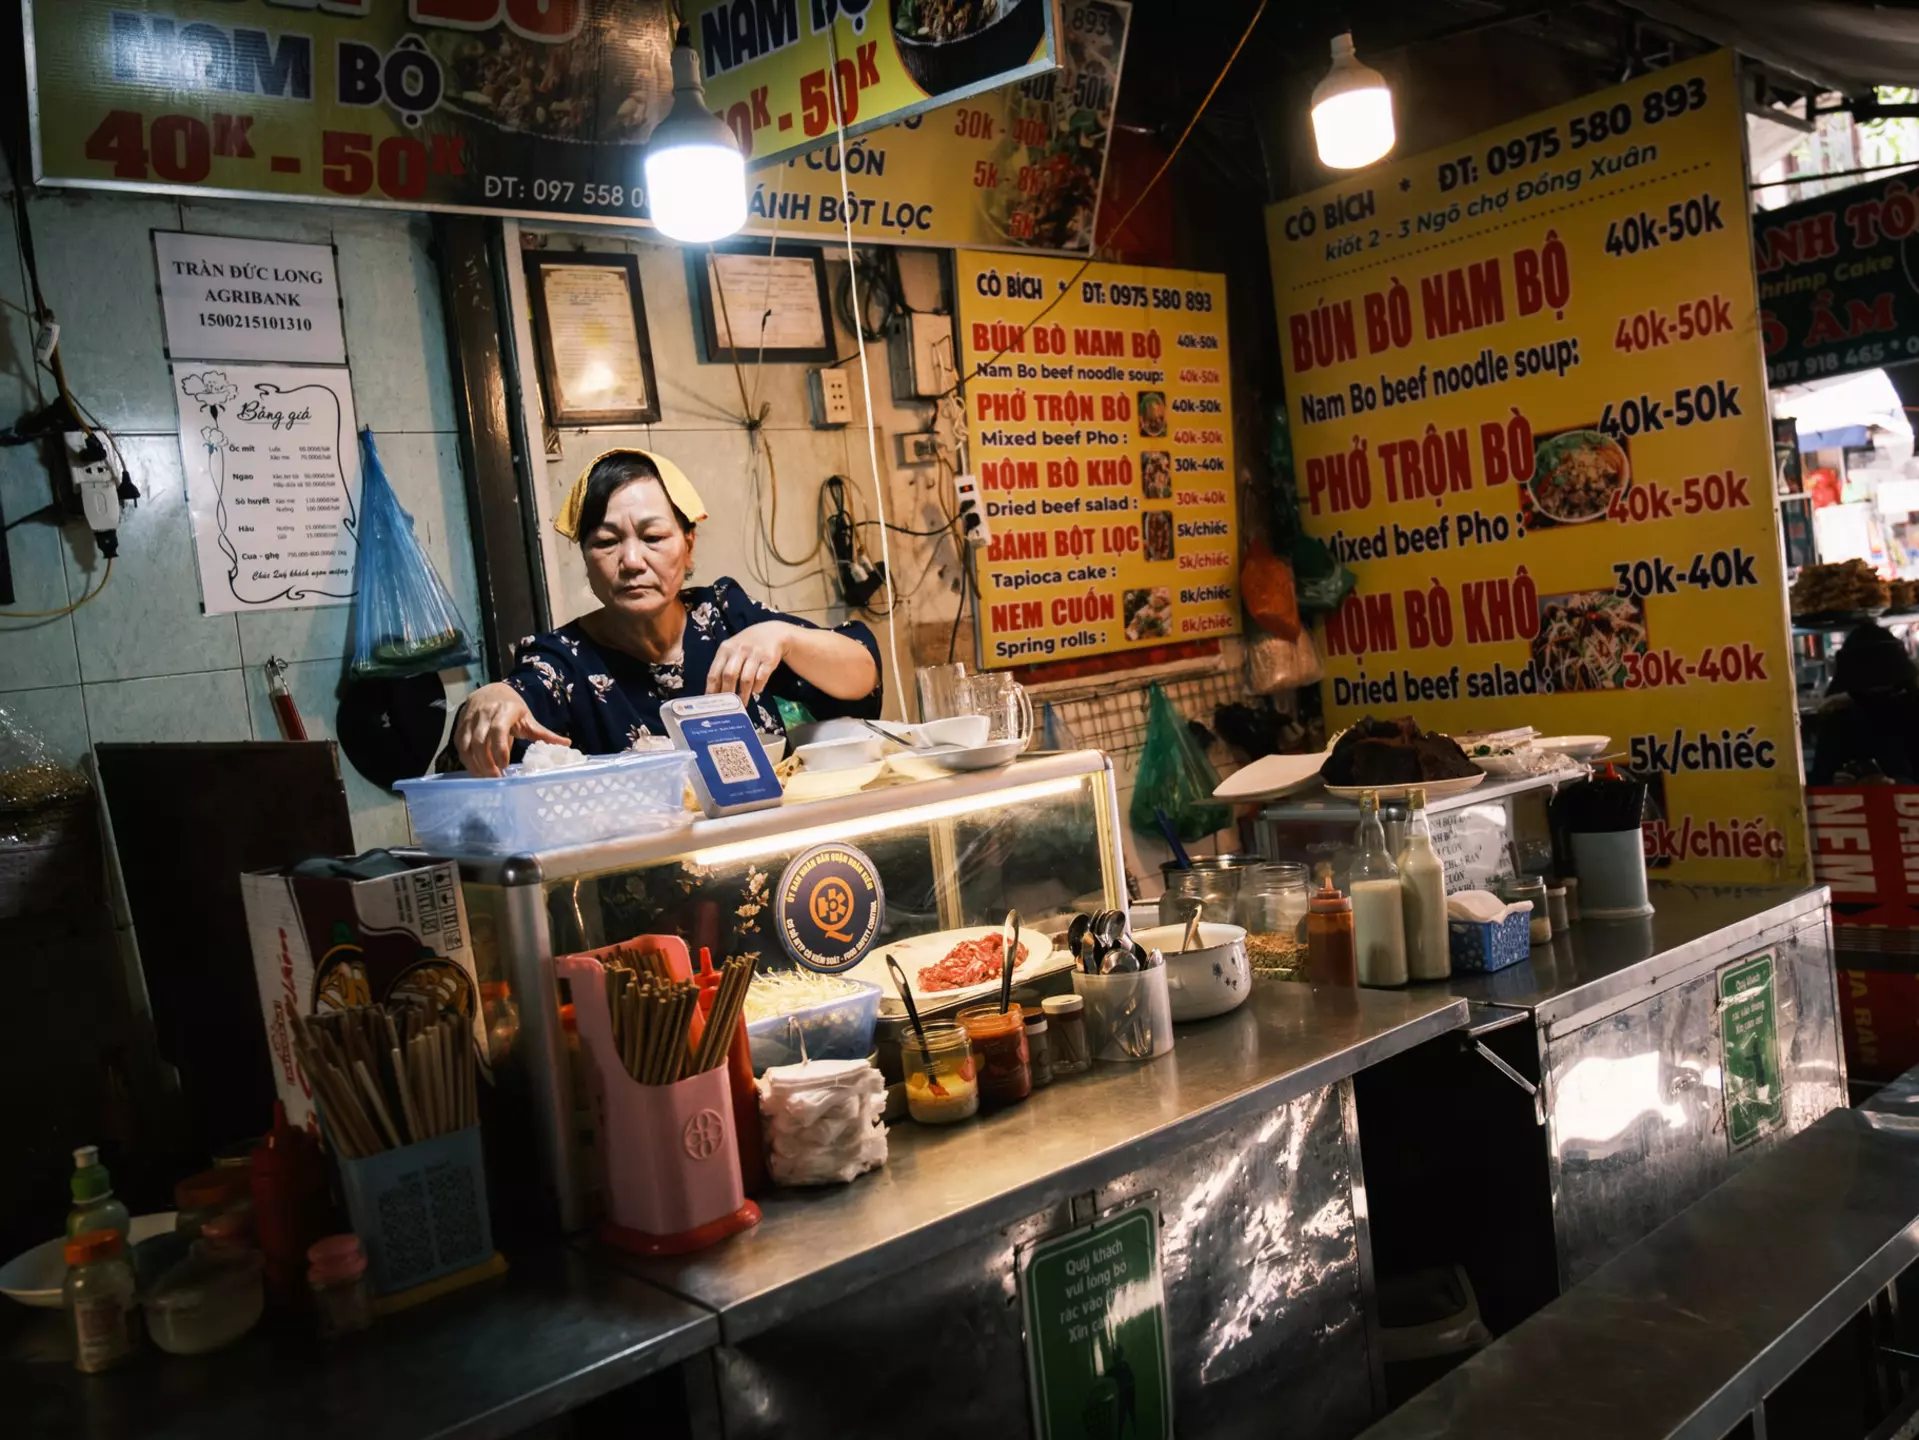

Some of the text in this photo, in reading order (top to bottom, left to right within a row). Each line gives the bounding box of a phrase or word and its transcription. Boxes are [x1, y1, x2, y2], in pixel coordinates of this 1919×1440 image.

[701, 0, 799, 78] NAM
[1073, 9, 1113, 36] 893
[338, 36, 442, 125] BỘ
[713, 40, 880, 158] 0K 50K
[955, 108, 995, 140] 30k
[1012, 117, 1048, 148] 40k
[85, 110, 465, 199] 40K 50K
[806, 138, 885, 176] CUỐN
[1284, 76, 1707, 242] CÔ BÍCH ĐT: 0975 580 893
[484, 176, 624, 206] ĐT: 097 558
[973, 160, 999, 189] 5k
[749, 183, 933, 235] ÁNH BỘT LỌC
[1325, 144, 1658, 262] kiốt 2 3 Ngõ chợ Đồng Xuân
[1846, 182, 1919, 248] TÔ
[1604, 194, 1724, 257] 40k-50k
[172, 258, 323, 285] TRẦN ĐỨC LONG
[976, 270, 1212, 312] CÔ BÍCH ĐT: 0975 580 893
[1761, 255, 1895, 299] hrimp Cake
[205, 288, 301, 307] AGRIBANK
[1289, 229, 1572, 374] BÚN BÒ NAM BỘ
[199, 313, 312, 331] 1500215101310
[972, 319, 1162, 364] BÚN BÒ NAM BỘ
[1614, 294, 1734, 354] 40k-50k
[1177, 334, 1219, 350] 40k-50k
[1805, 352, 1839, 375] 918
[1845, 342, 1884, 365] 465
[977, 363, 1164, 385] Nam Bo beef noodle soup:
[1179, 370, 1220, 384] 40k-50k
[1301, 337, 1581, 425] Nam Bo beef noodle soup:
[237, 400, 311, 430] Bảng giá
[977, 388, 1131, 427] PHỞ TRỘN BÒ
[1172, 400, 1222, 414] 40k-50k
[1599, 380, 1743, 440] 40k-50k
[981, 431, 1119, 446] Mixed beef Pho
[1173, 431, 1223, 444] 40k-50k
[232, 473, 254, 481] Ngao
[982, 456, 1133, 495] NỘM BÒ KHÔ
[1174, 458, 1225, 473] 30k-40k
[1306, 406, 1536, 517] PHỞ TRỘN BÒ
[986, 496, 1129, 517] Dried beef salad
[1175, 491, 1226, 506] 30k-40k
[1607, 470, 1751, 525] 40k-50k
[987, 524, 1140, 562] BÁNH BỘT LỌC
[1177, 521, 1228, 537] 5k/chiếc
[1394, 515, 1449, 556] beef
[1457, 510, 1510, 548] Pho
[992, 566, 1107, 590] Tapioca cake
[1178, 551, 1230, 569] 5k/chiếc
[1612, 548, 1758, 598] 30k-40k
[991, 587, 1114, 633] NEM CUỐN
[1180, 583, 1231, 603] 8k/chiếc
[1407, 577, 1454, 649] BÒ
[1461, 564, 1540, 645] KHÔ
[1181, 614, 1232, 633] 8k/chiếc
[996, 631, 1098, 658] Spring rolls
[1334, 659, 1540, 706] Dried beef salad
[1622, 643, 1768, 688] 30k-40k
[1630, 726, 1776, 775] 5k/chiếc
[1643, 815, 1785, 862] 5k/chiếc
[1812, 793, 1877, 893] NEM
[1065, 1253, 1091, 1276] Quý
[1065, 1279, 1084, 1299] vui
